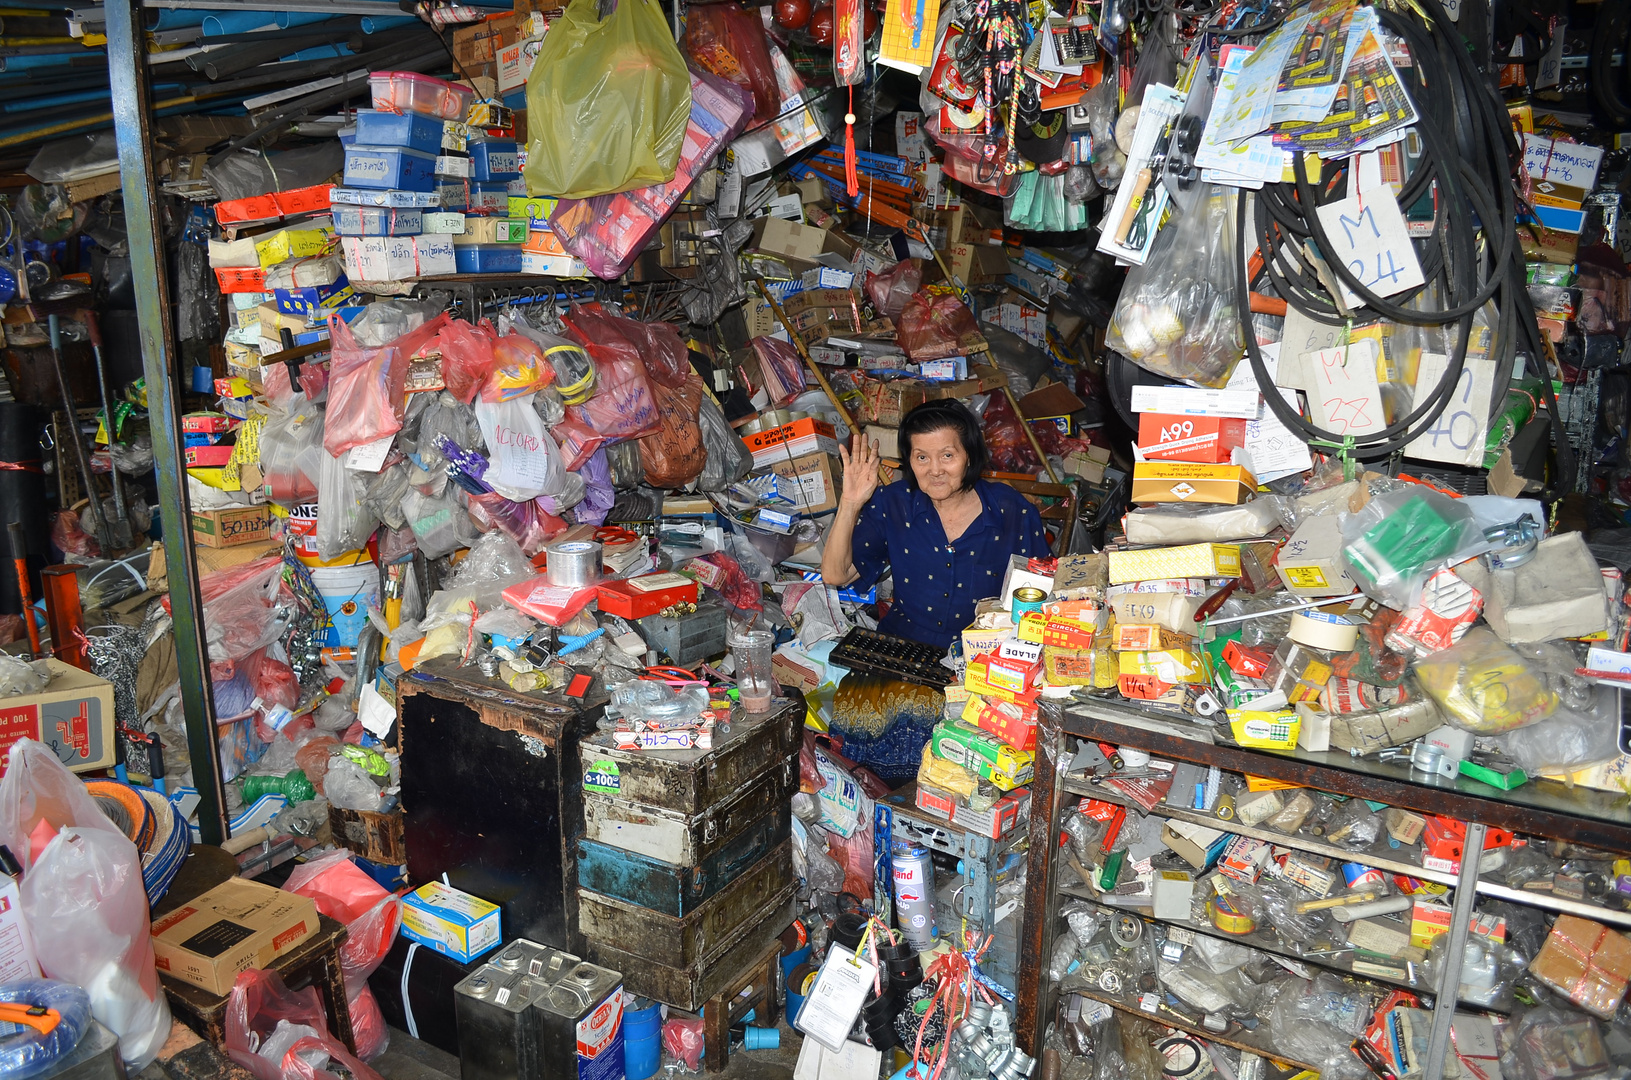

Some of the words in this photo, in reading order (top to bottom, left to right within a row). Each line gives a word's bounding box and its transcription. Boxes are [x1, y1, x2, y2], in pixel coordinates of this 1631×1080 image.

[1339, 205, 1381, 249] M
[1151, 444, 1168, 452] Strength
[1168, 440, 1180, 448] Quick
[1181, 438, 1195, 446] Drying
[1195, 434, 1214, 442] Adhesive
[1004, 647, 1037, 660] BLADE
[13, 713, 29, 723] 100
[1246, 724, 1270, 733] Panasonic
[940, 742, 965, 756] Panasonic
[994, 772, 1002, 782] C
